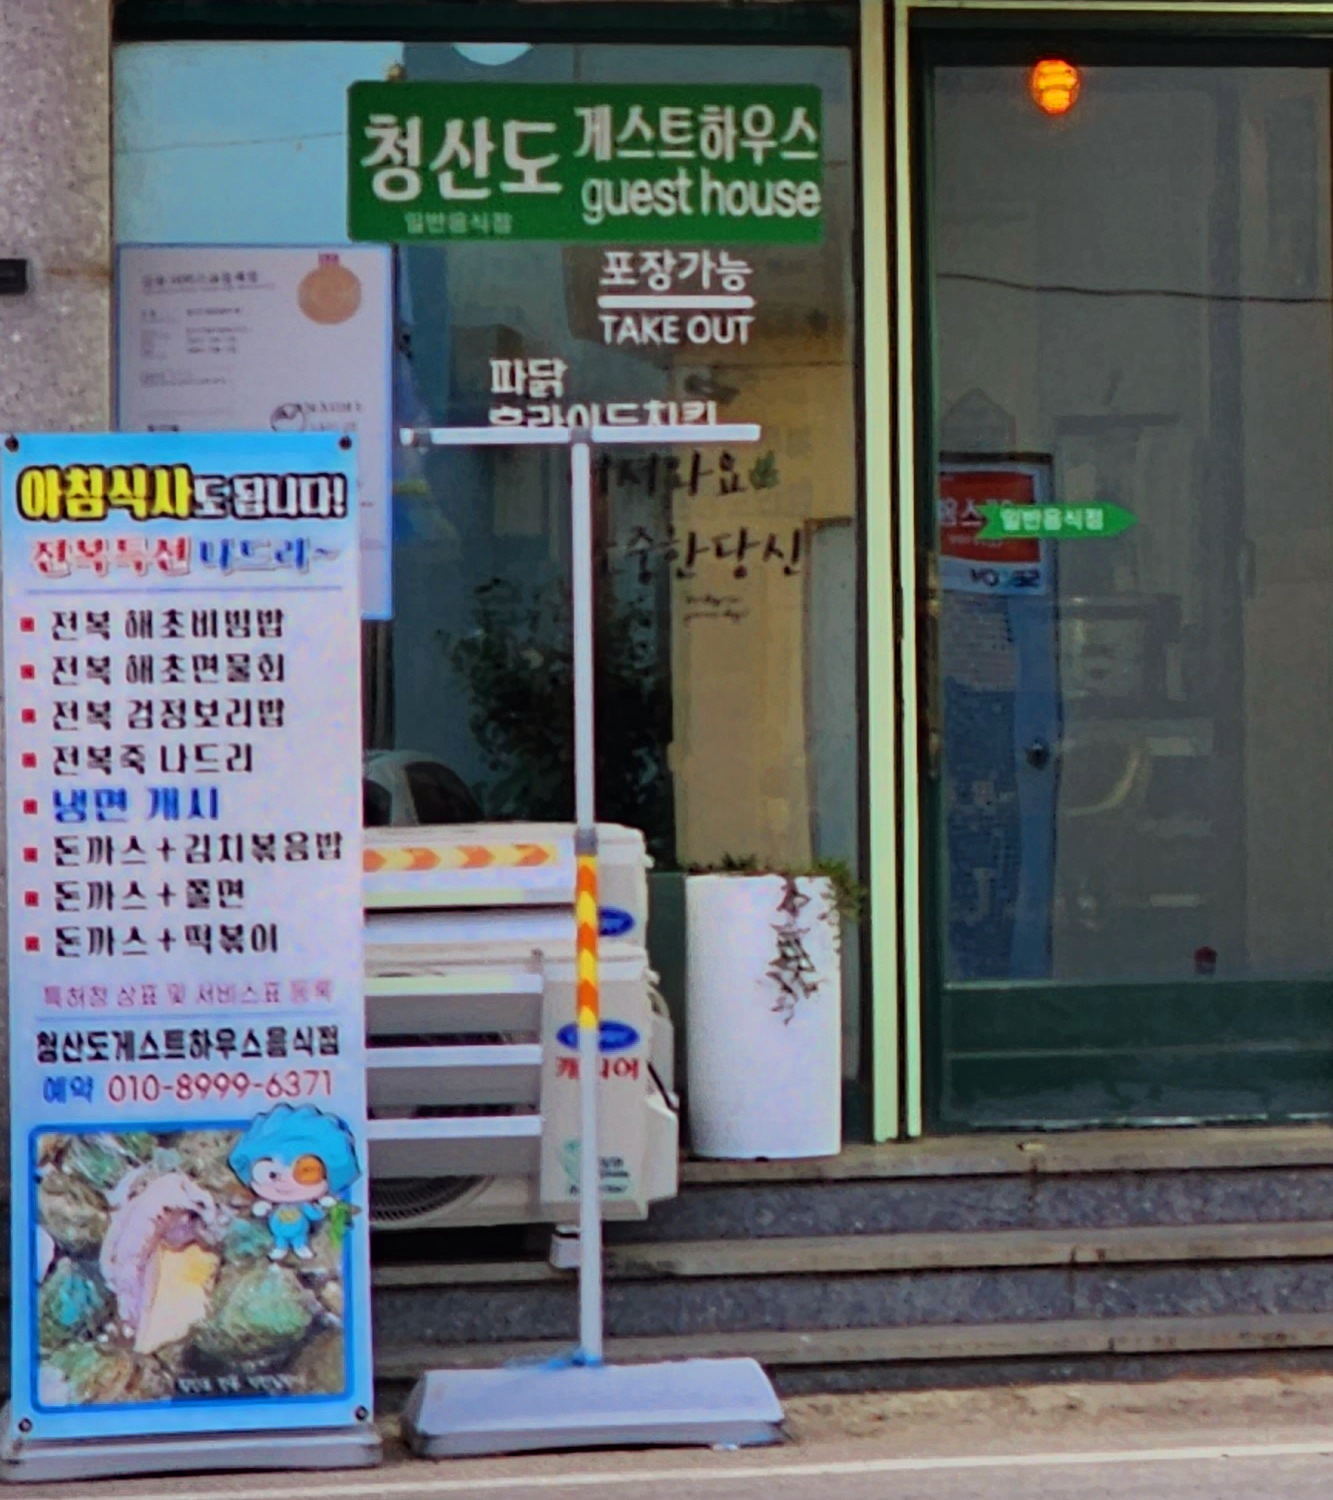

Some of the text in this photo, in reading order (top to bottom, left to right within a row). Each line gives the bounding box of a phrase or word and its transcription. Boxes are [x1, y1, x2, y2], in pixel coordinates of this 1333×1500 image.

[361, 104, 819, 201] 청산도 게스트하우스
[580, 166, 823, 225] guest house
[600, 250, 753, 291] 포장가능
[598, 314, 755, 345] TAKE OUT
[489, 358, 568, 399] 파닭
[51, 608, 285, 640] 전복 해초비빔밥
[51, 654, 112, 686] 전복
[52, 698, 285, 731] 전복 검정보리밥
[52, 743, 254, 776] 전복죽 나드리
[52, 786, 219, 823] 냉면 개시
[43, 1069, 332, 1103] 예약 010-8999-6371
